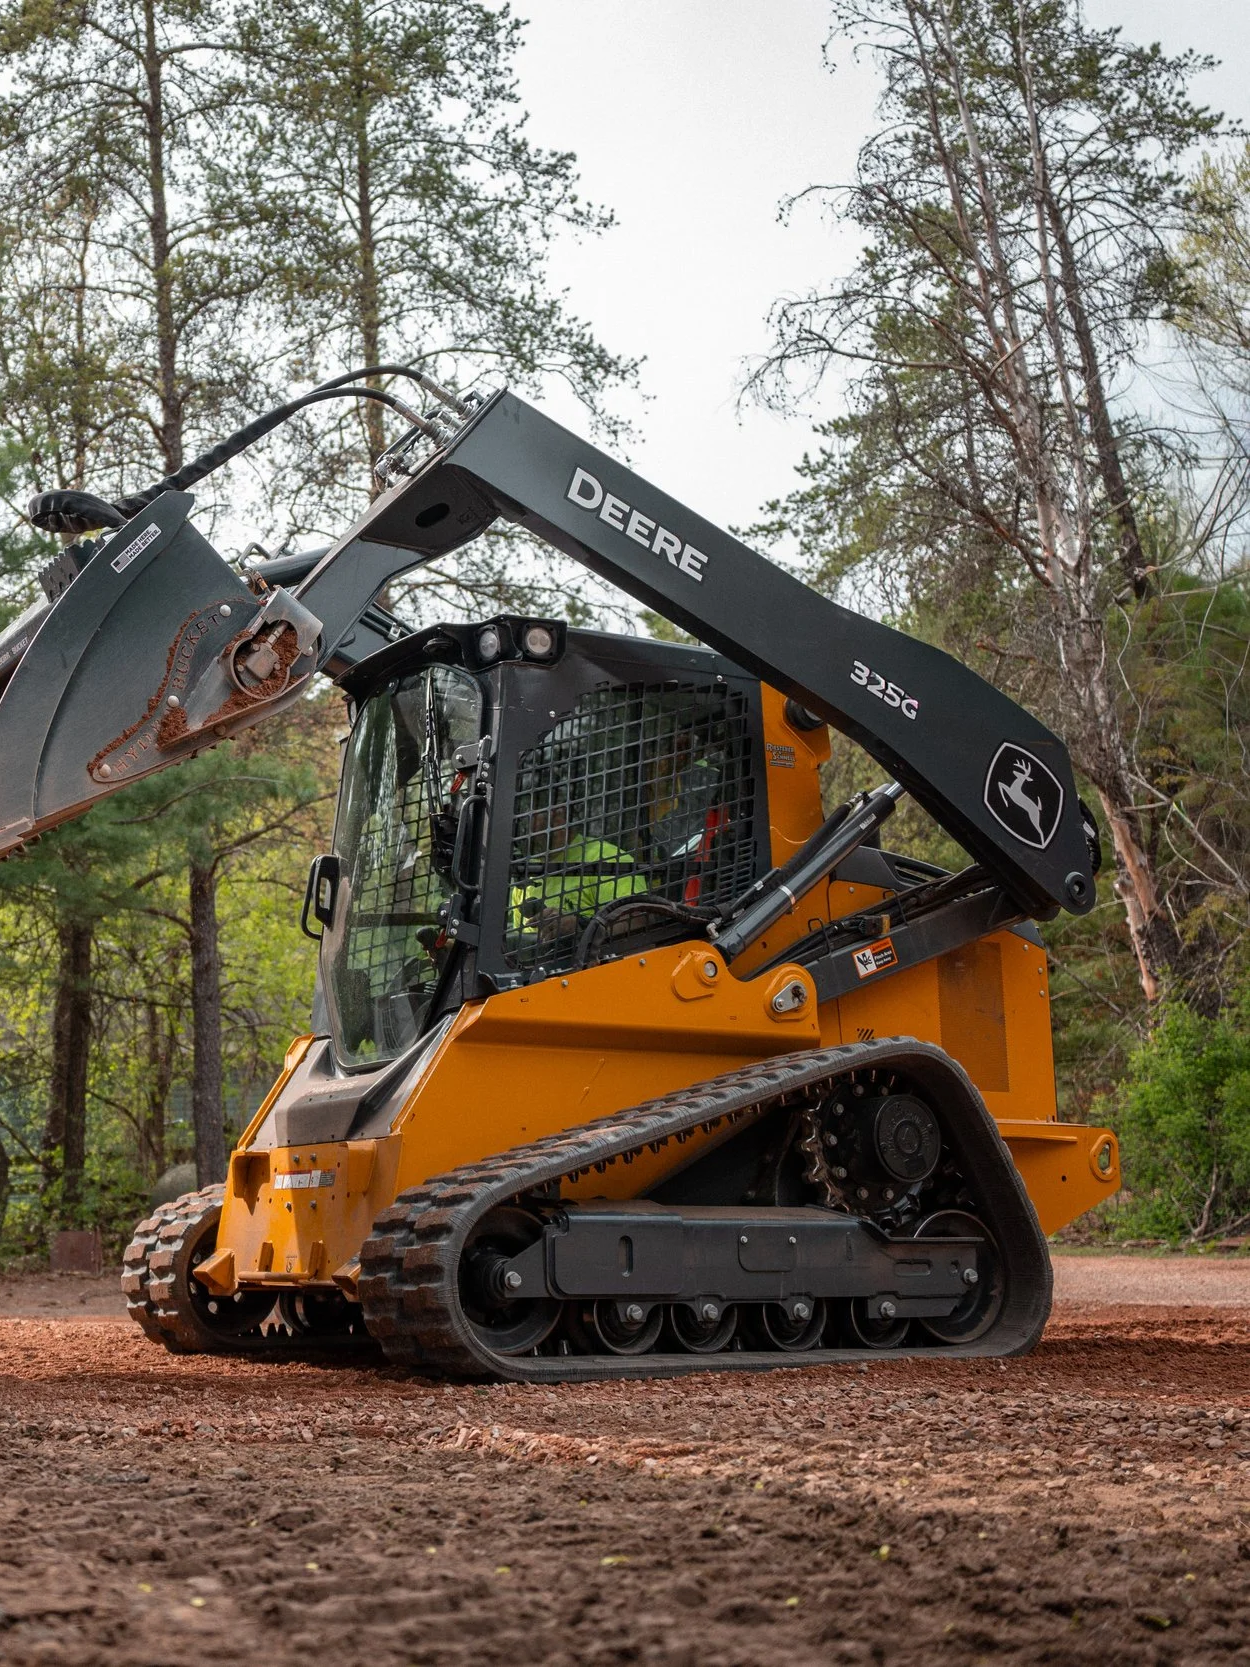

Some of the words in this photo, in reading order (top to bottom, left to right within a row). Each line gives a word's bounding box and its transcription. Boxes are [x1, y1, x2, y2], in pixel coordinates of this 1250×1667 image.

[124, 541, 139, 555] MADE
[137, 530, 152, 543] HERE.
[128, 545, 143, 559] MADE
[567, 467, 708, 581] DEERE
[114, 707, 171, 774] HYDR
[172, 613, 219, 690] BUCKET
[850, 660, 919, 720] 325G
